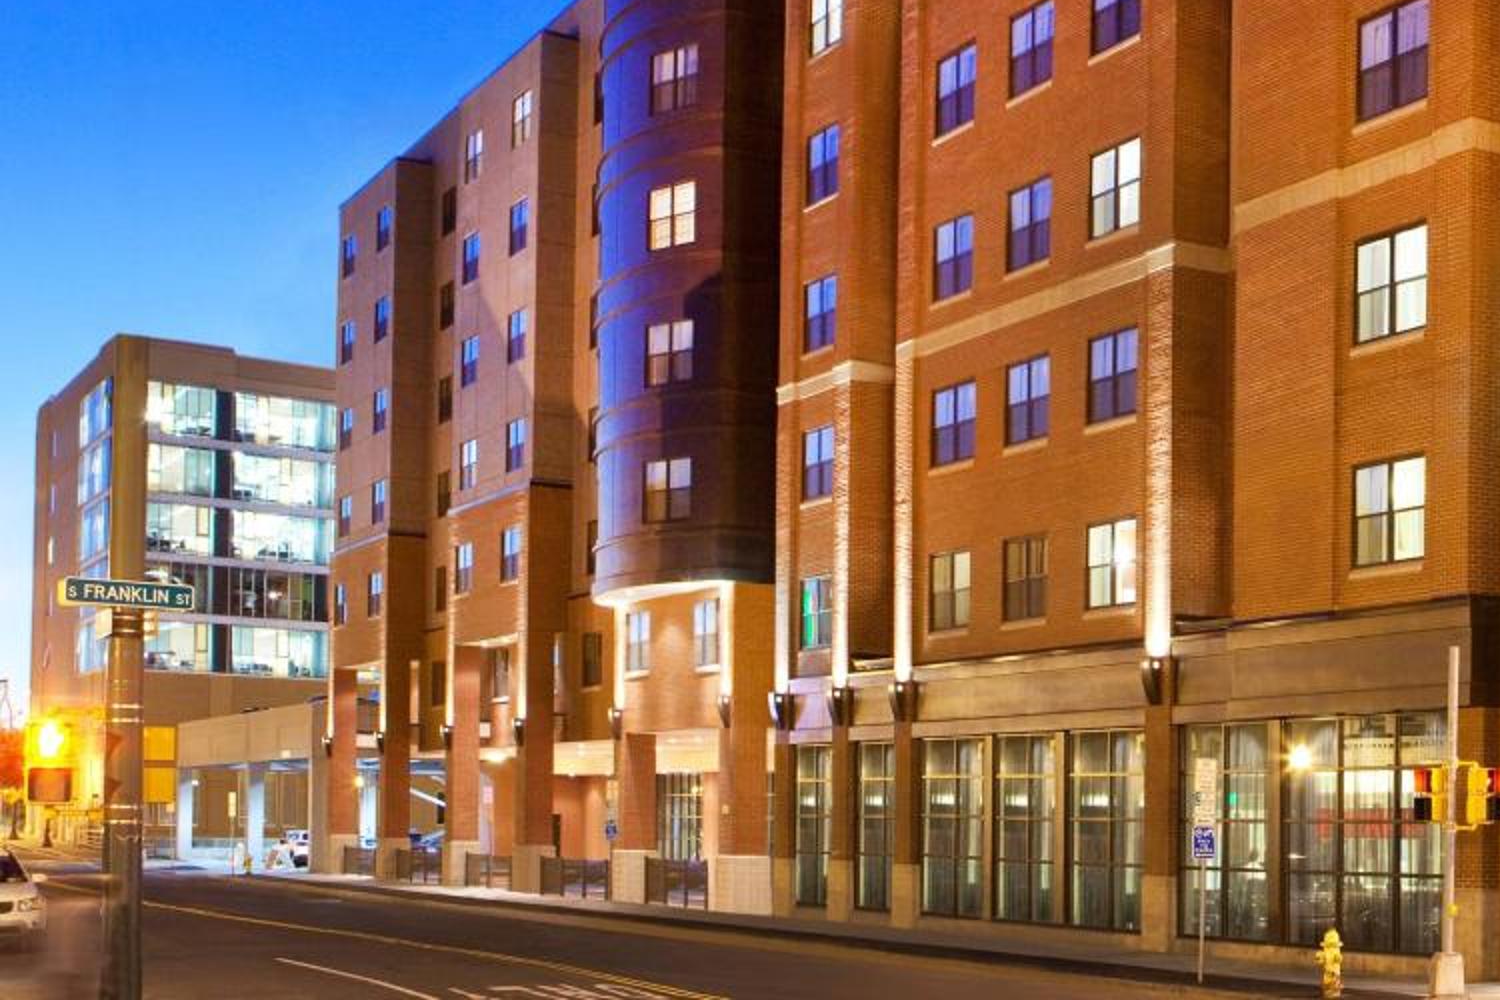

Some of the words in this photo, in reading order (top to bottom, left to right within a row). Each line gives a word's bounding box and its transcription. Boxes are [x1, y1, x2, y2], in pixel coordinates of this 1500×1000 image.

[68, 585, 78, 598] S
[83, 583, 170, 604] FRANKLIN
[175, 593, 191, 606] ST
